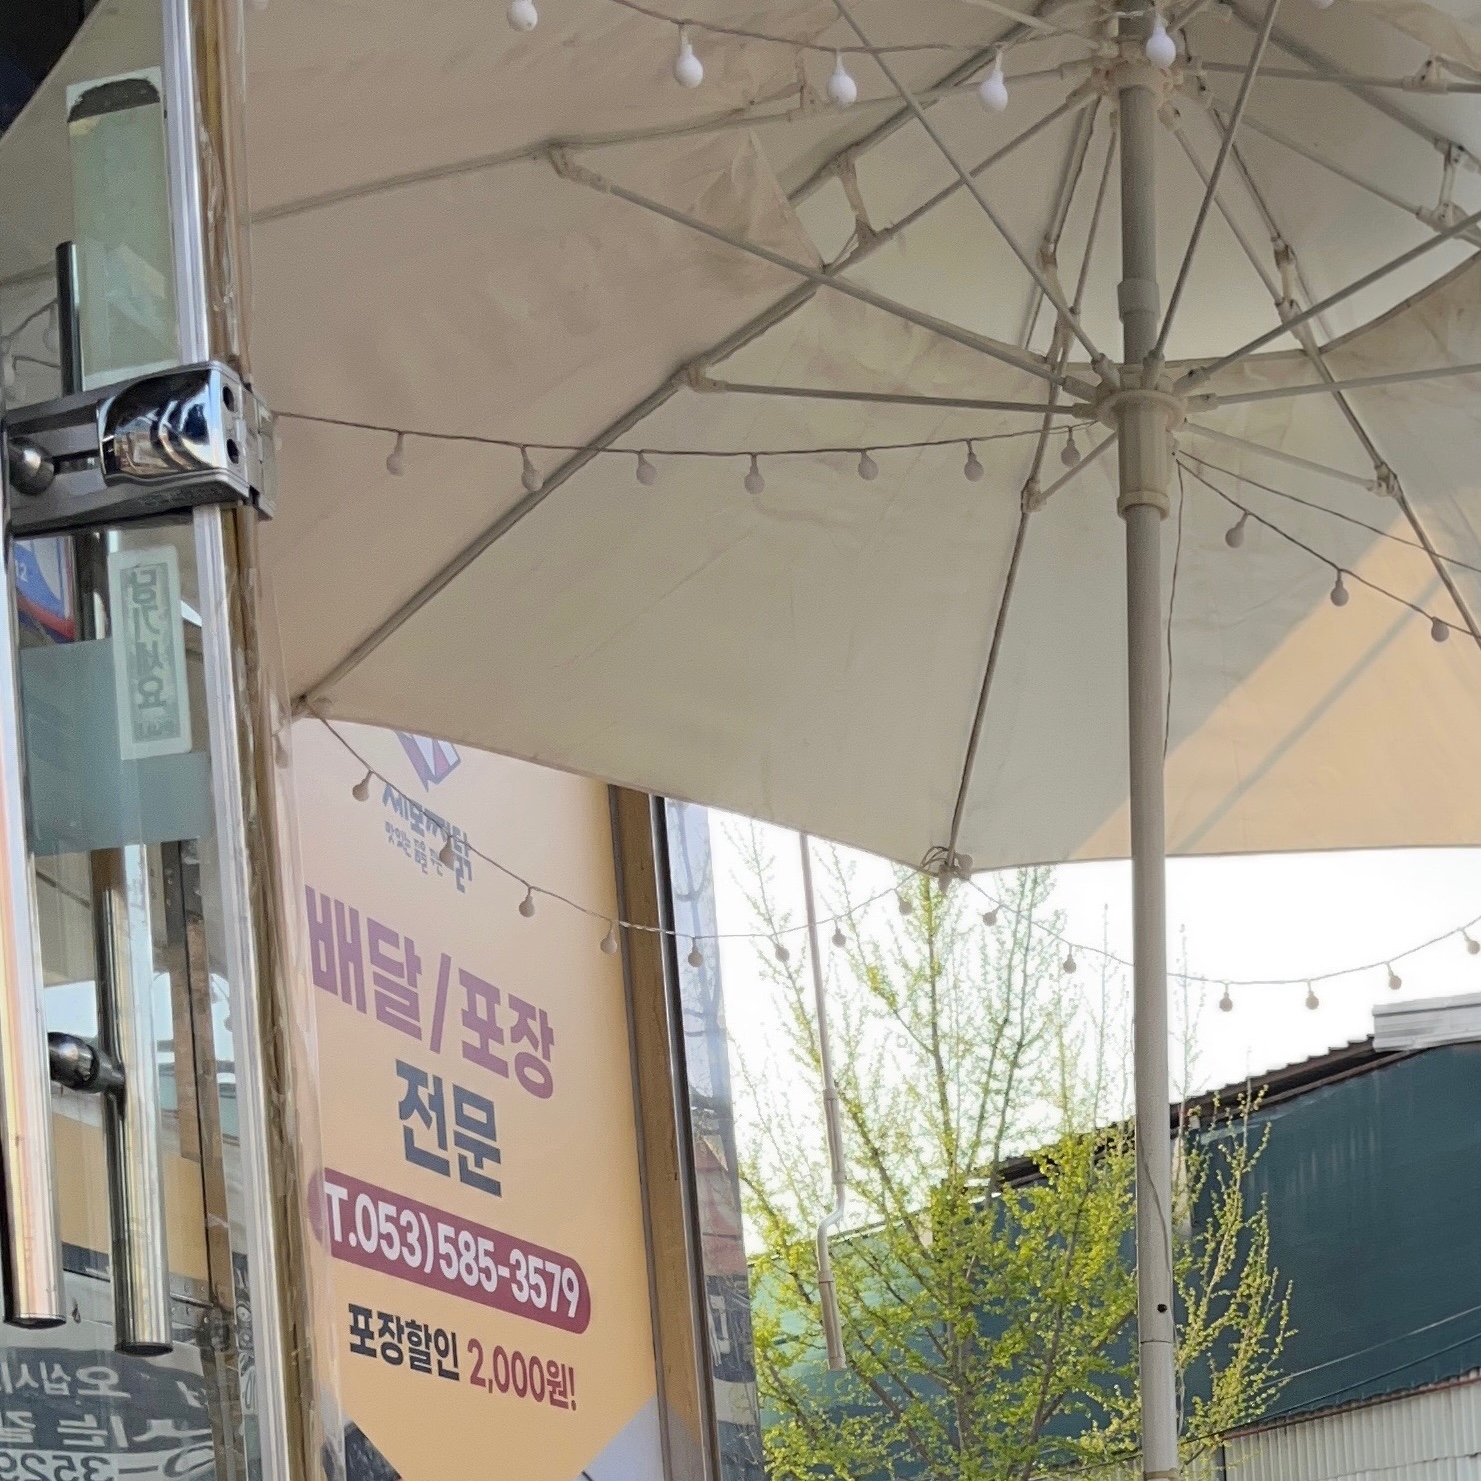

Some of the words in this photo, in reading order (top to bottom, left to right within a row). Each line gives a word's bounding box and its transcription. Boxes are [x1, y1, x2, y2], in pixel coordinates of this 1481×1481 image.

[305, 884, 555, 1099] 배달/포장
[395, 1058, 502, 1198] 전문
[323, 1181, 580, 1318] T.053)585-3579
[348, 1303, 460, 1381] 포장할인
[467, 1338, 577, 1412] 2,000원!
